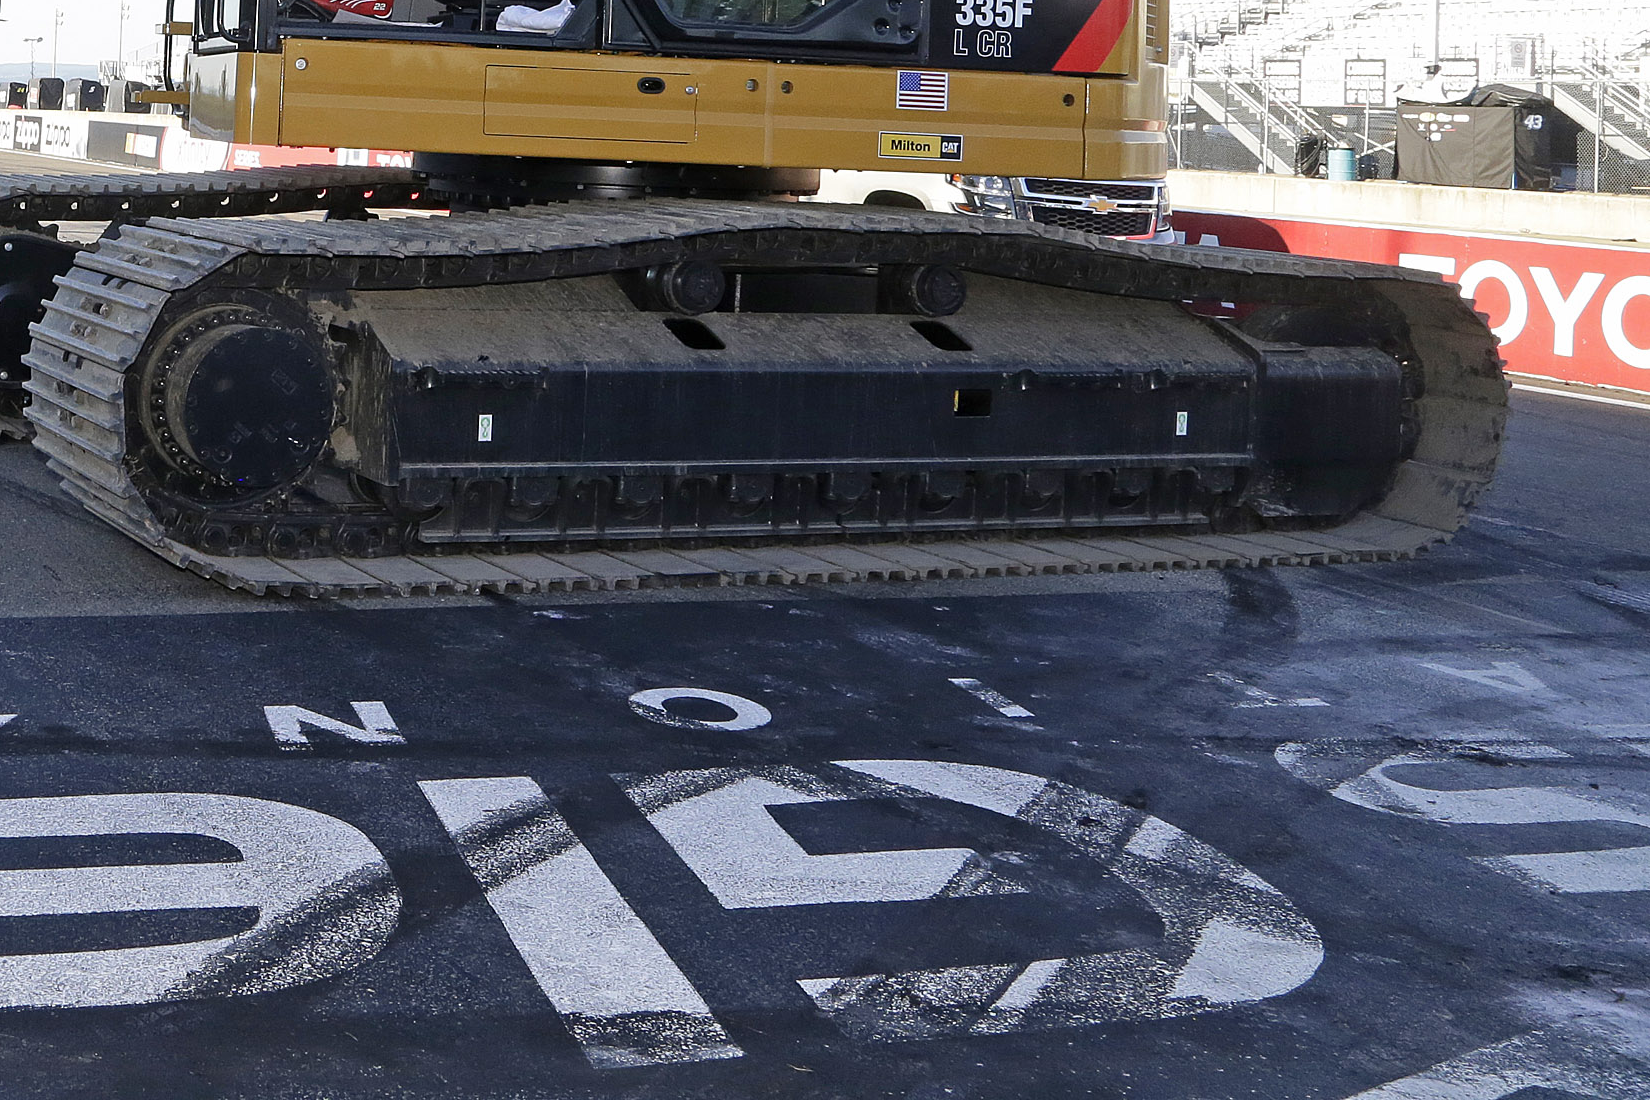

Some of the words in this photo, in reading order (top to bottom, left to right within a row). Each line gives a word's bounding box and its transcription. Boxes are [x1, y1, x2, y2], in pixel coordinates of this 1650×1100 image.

[373, 2, 387, 11] 22
[953, 28, 969, 56] L
[976, 29, 1012, 58] CR
[1523, 114, 1544, 130] 43
[890, 139, 931, 152] Milton
[942, 142, 959, 153] CAT
